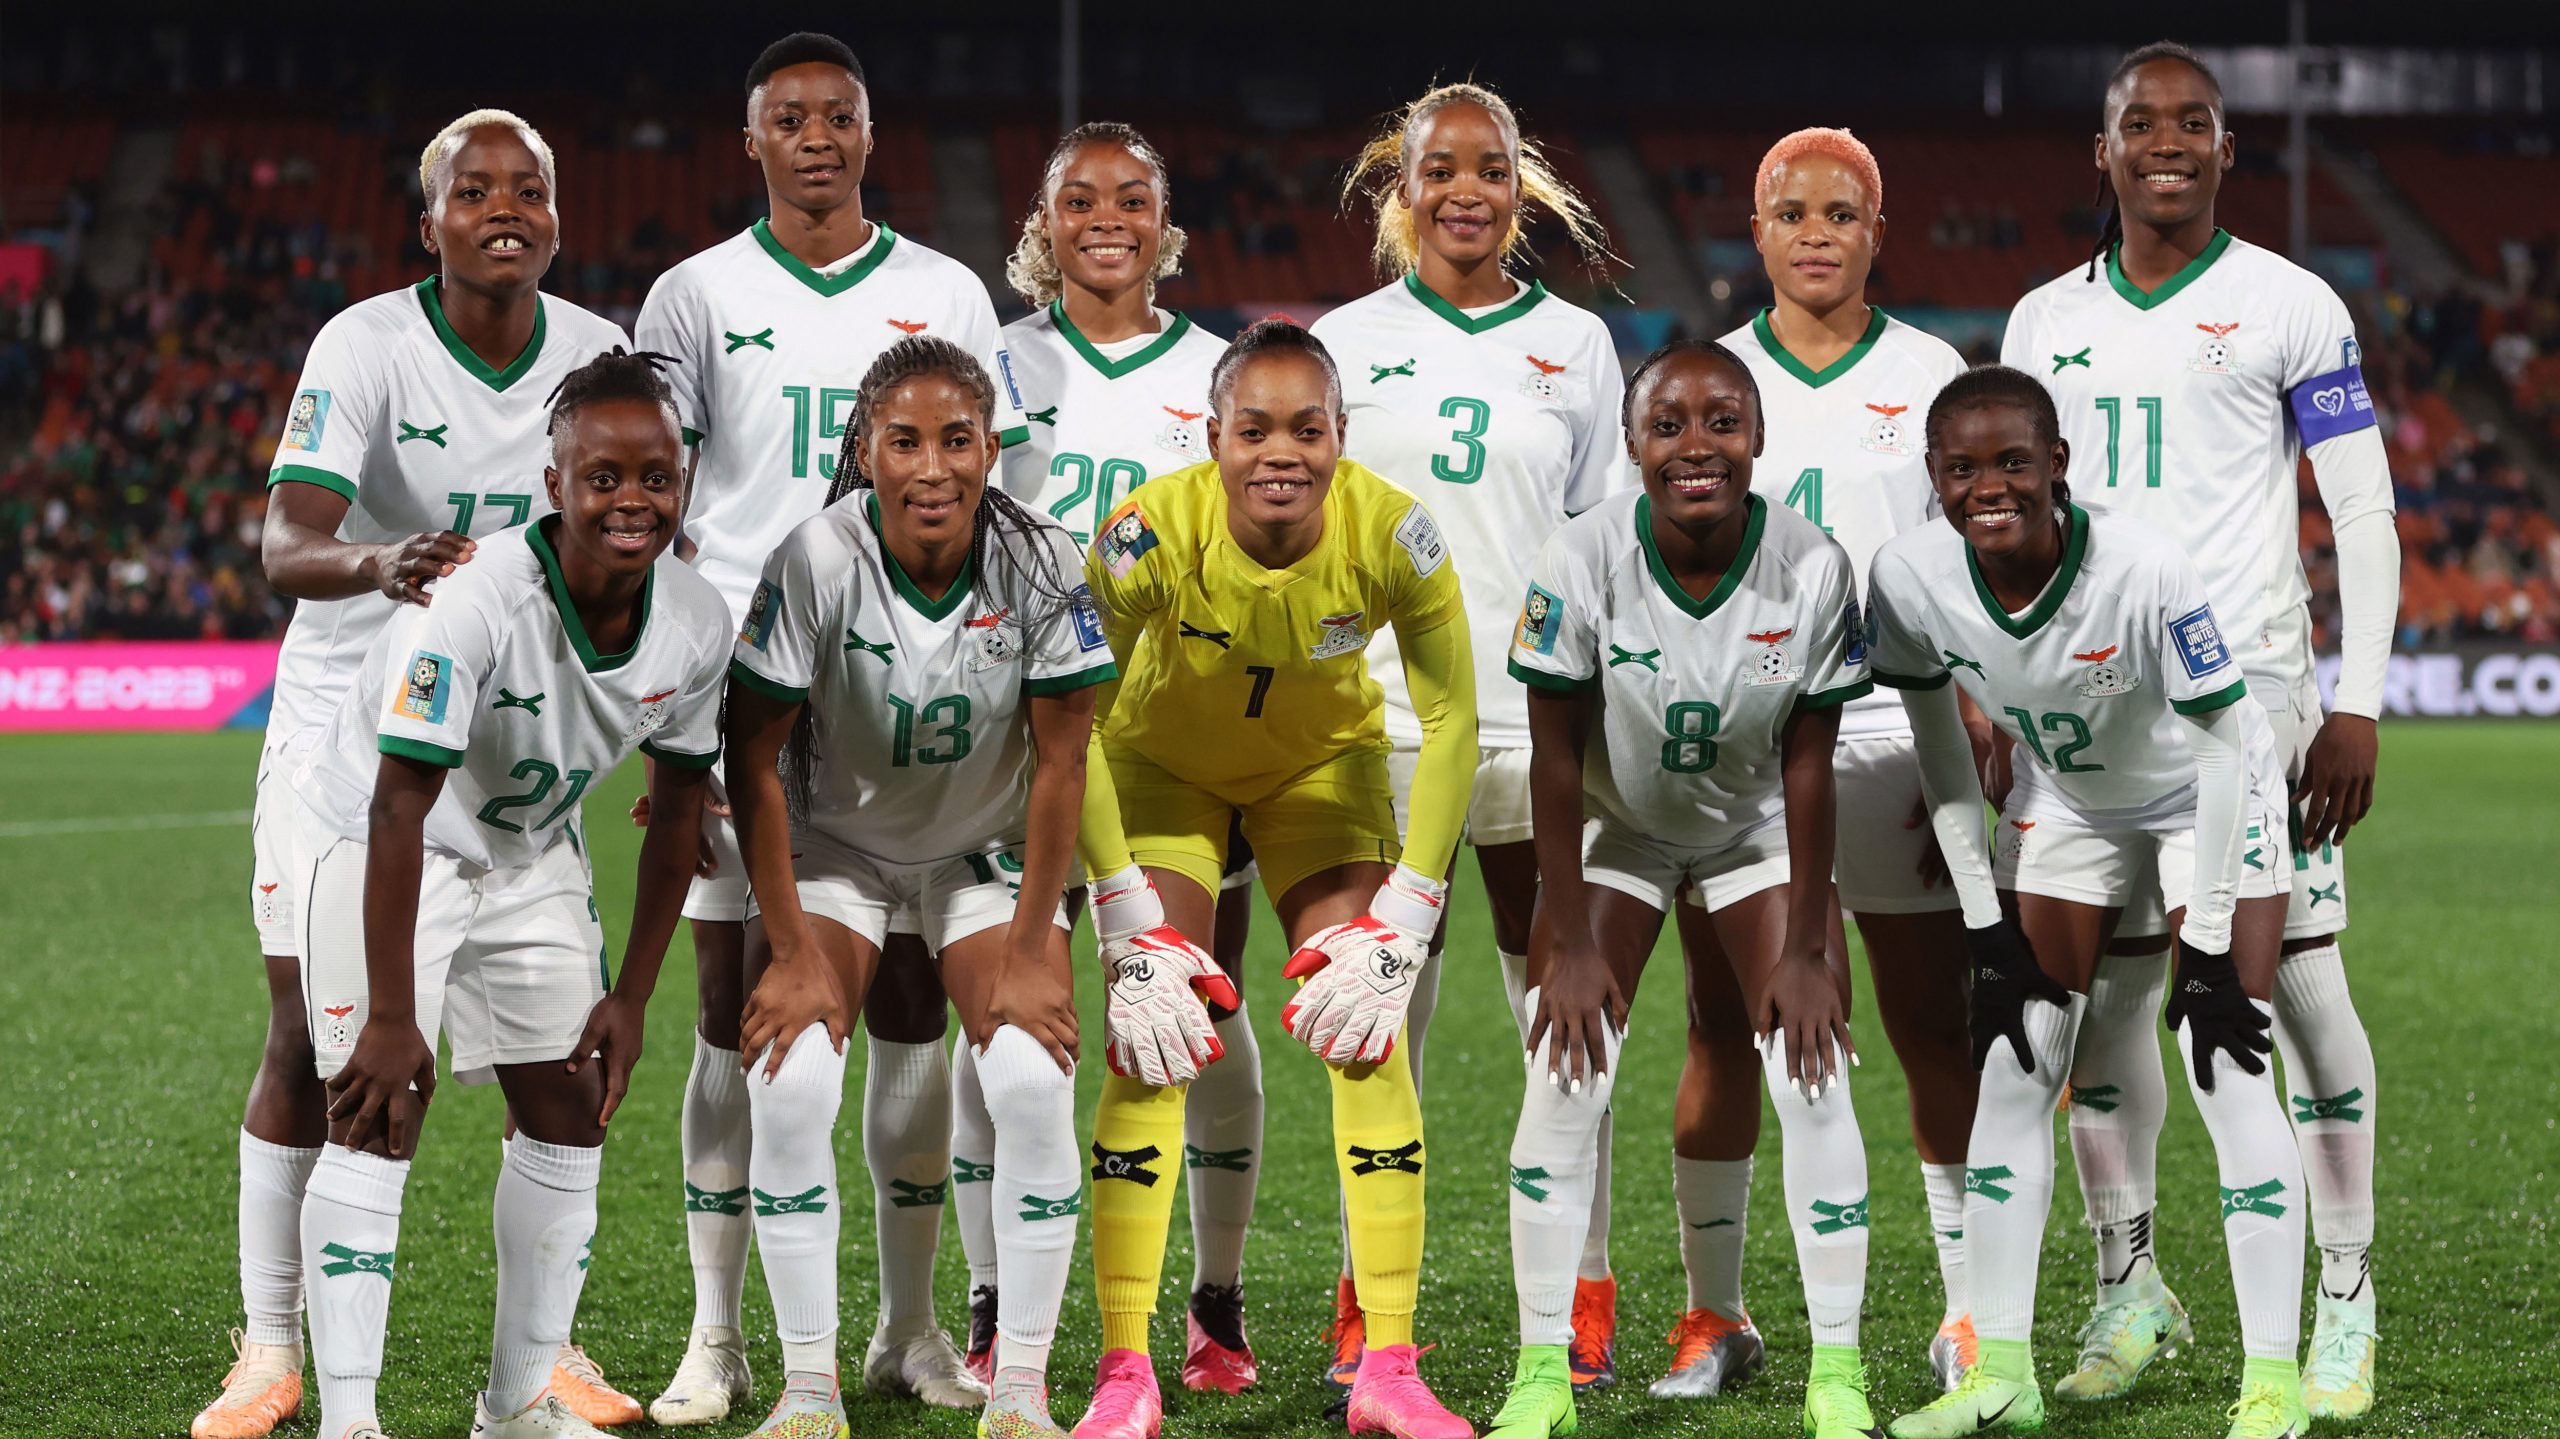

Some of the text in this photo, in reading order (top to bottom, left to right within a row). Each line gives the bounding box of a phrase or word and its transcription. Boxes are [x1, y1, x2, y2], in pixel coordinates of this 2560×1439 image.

[782, 385, 857, 480] 15
[1431, 396, 1491, 485] 3
[2095, 397, 2162, 488] 11
[1048, 452, 1147, 545] 20
[1784, 468, 1834, 538] 4
[1407, 513, 1427, 538] FOOTBALL
[1414, 519, 1433, 546] UNITES
[2182, 616, 2211, 636] FOOTBALL
[2185, 625, 2216, 646] UNITES
[1327, 644, 1352, 656] ZAMBIA
[2189, 645, 2203, 657] the
[2204, 652, 2218, 662] FIFA
[1758, 675, 1788, 684] ZAMBIA
[2096, 686, 2126, 696] ZAMBIA
[888, 692, 971, 768] 13
[1661, 701, 1720, 774] 8
[2003, 706, 2106, 773] 12
[476, 758, 593, 834] 21
[2311, 1102, 2336, 1116] Cu
[1104, 1155, 1131, 1175] Cu
[1372, 1152, 1402, 1167] Cu
[1965, 1171, 1983, 1190] Cu
[699, 1195, 724, 1209] Cu
[773, 1200, 801, 1212] Cu
[1046, 1202, 1071, 1216] Cu
[2231, 1192, 2255, 1208] Cu
[1839, 1207, 1863, 1224] Cu
[352, 1254, 381, 1269] Cu
